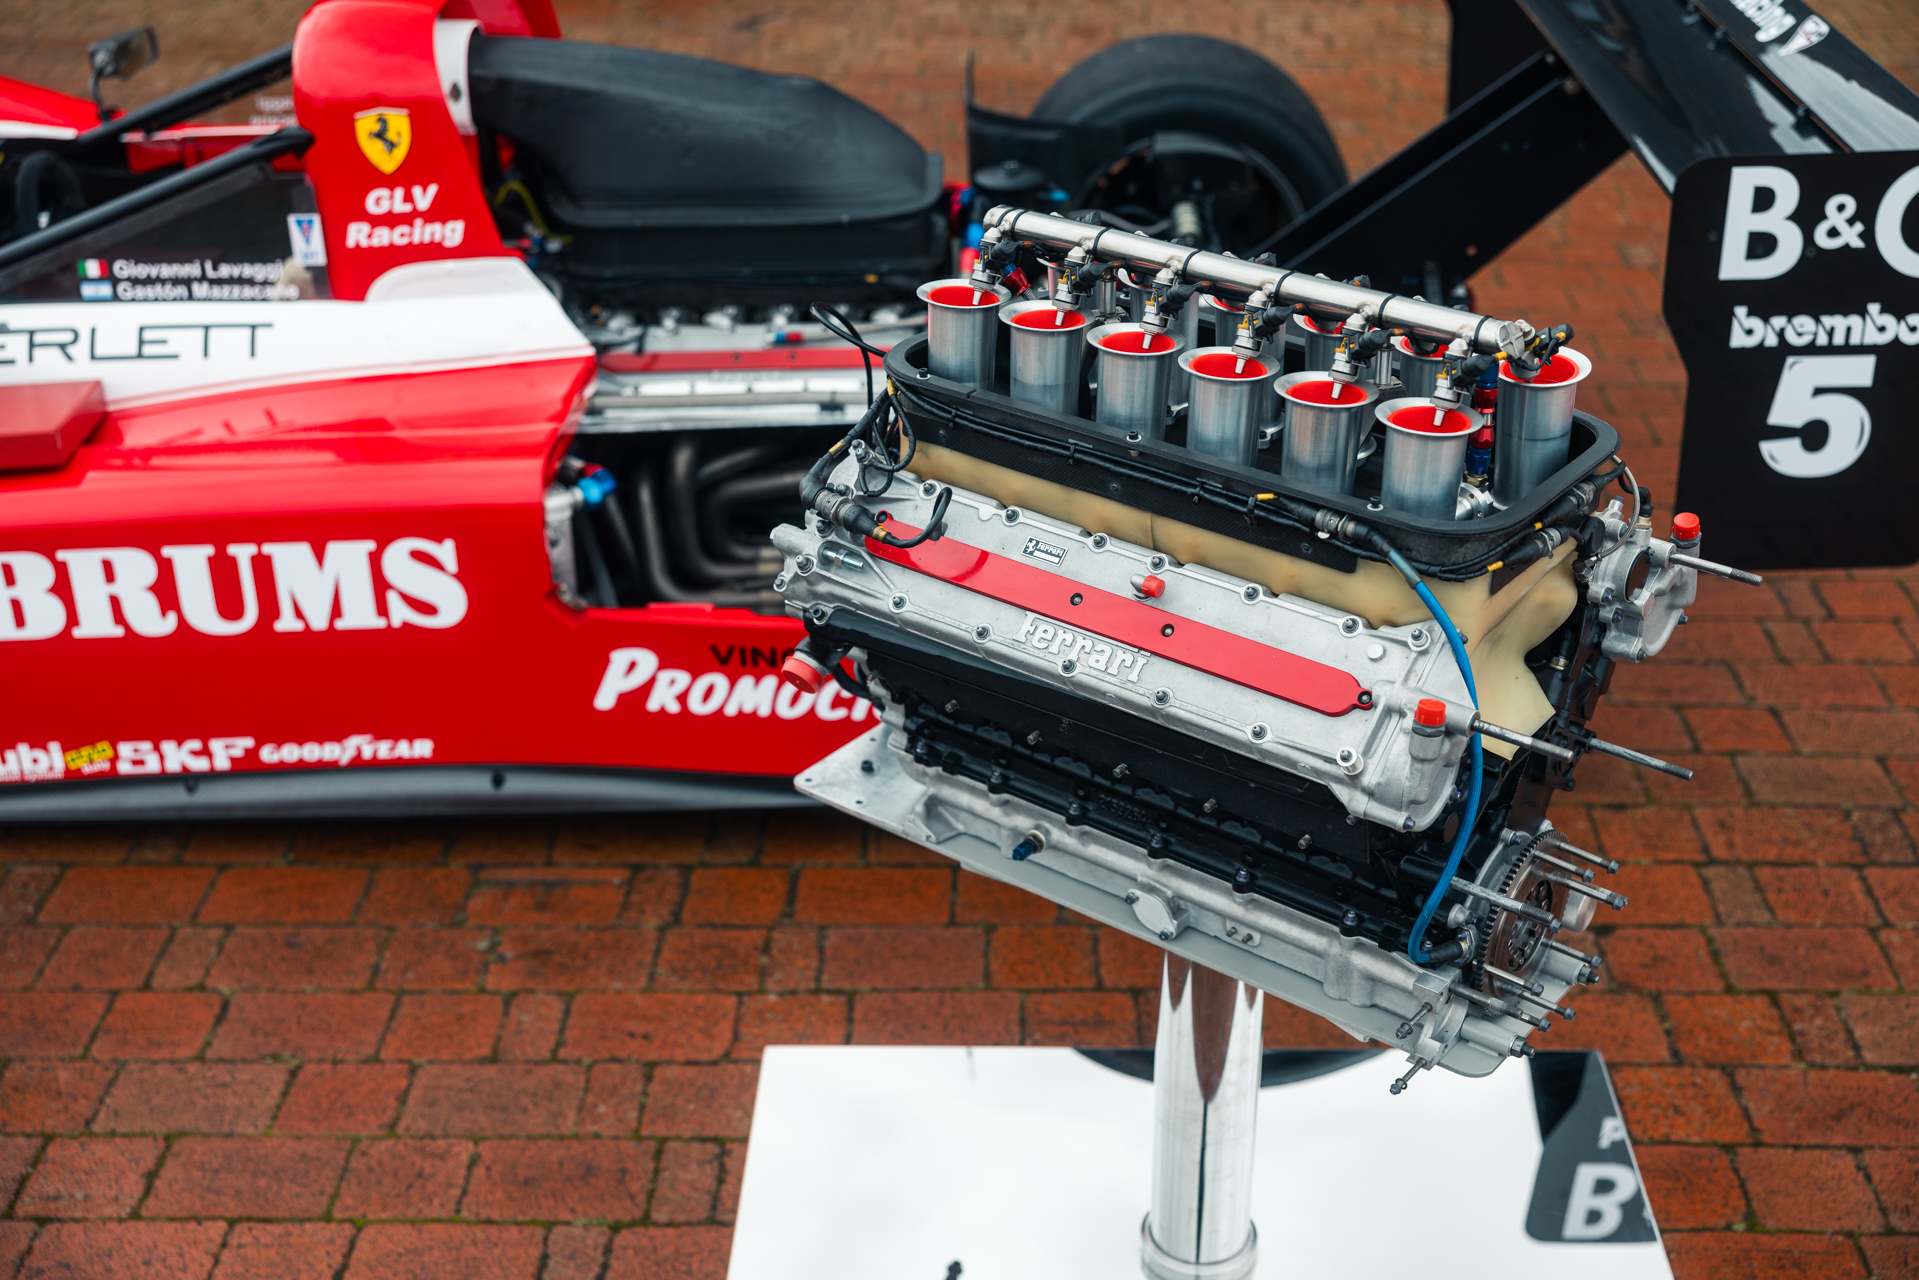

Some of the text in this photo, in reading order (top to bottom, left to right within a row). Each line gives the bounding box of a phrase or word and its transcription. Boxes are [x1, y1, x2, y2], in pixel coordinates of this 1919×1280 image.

[364, 182, 440, 215] GLV
[345, 217, 465, 249] Racing
[112, 258, 284, 282] Giovanni Lavaggi
[1729, 302, 1919, 349] brembo
[1758, 354, 1877, 478] 5
[0, 536, 468, 642] BRUMS
[709, 644, 798, 669] VIN
[1012, 611, 1151, 683] Ferrari
[593, 647, 882, 722] PROMOCI
[116, 736, 255, 775] SKF
[259, 734, 434, 766] GOODYEAR
